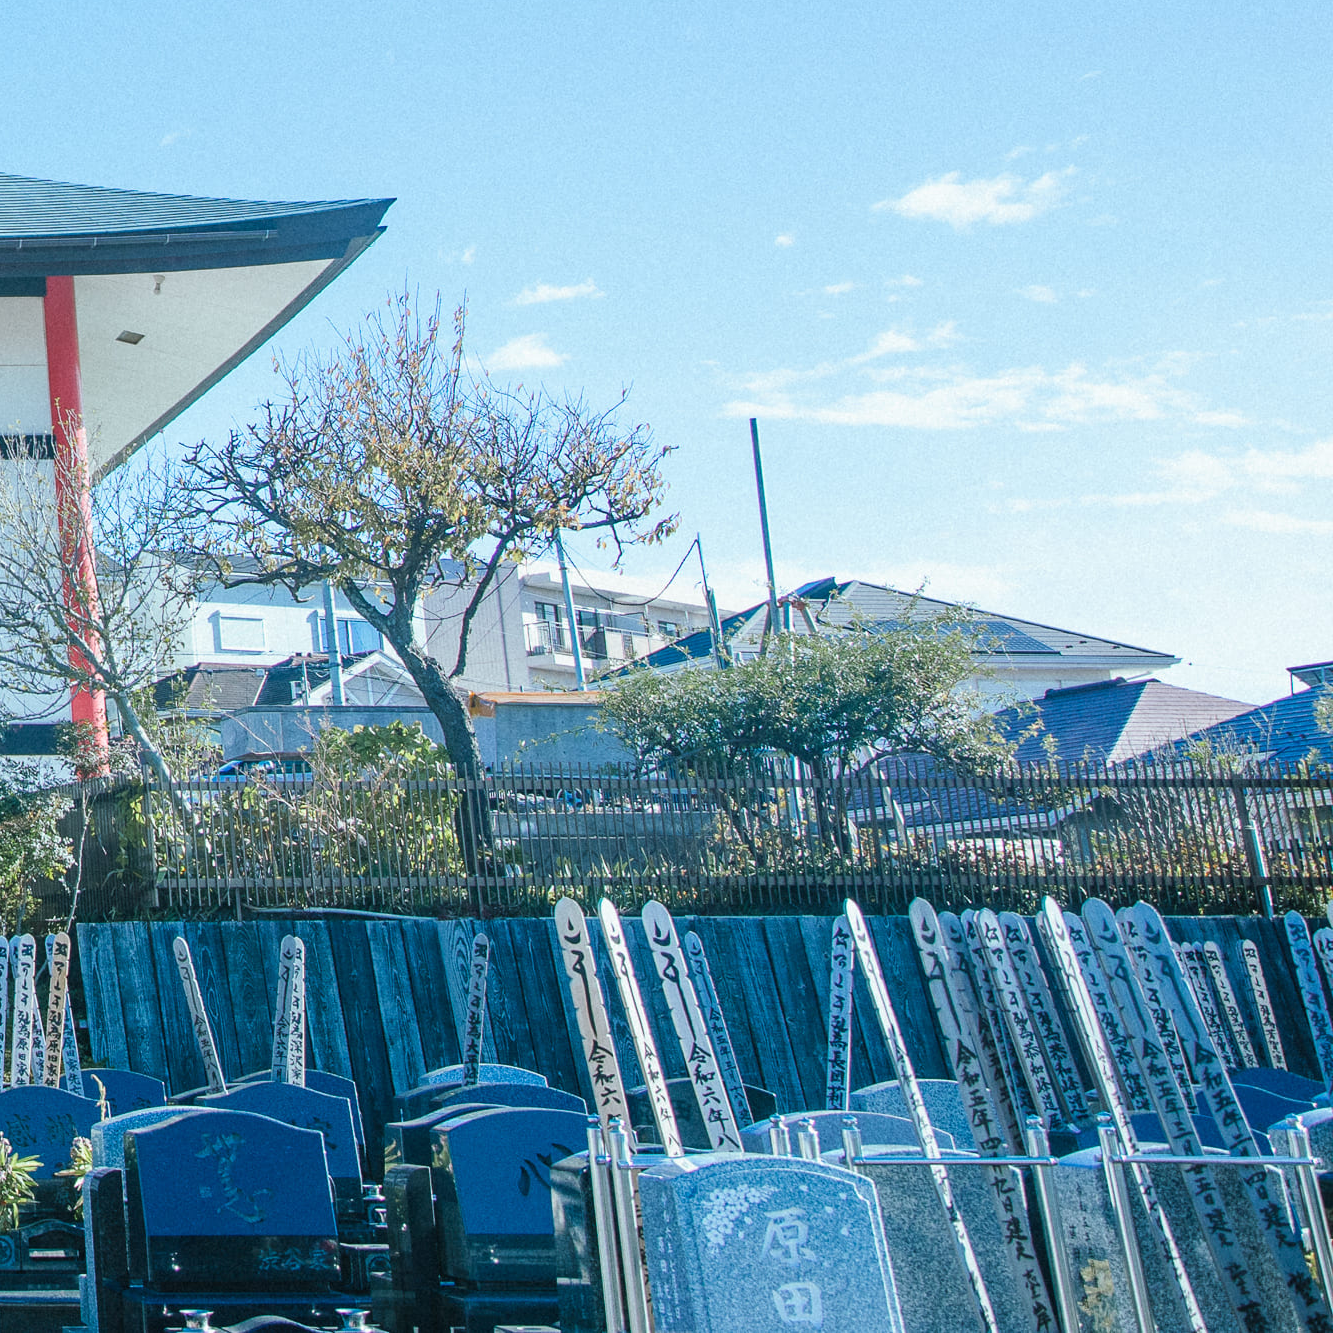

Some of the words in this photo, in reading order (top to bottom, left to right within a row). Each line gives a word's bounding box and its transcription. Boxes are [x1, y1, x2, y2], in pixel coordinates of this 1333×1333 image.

[644, 1041, 681, 1155] 令和六年八
[759, 1206, 824, 1331] 原田
